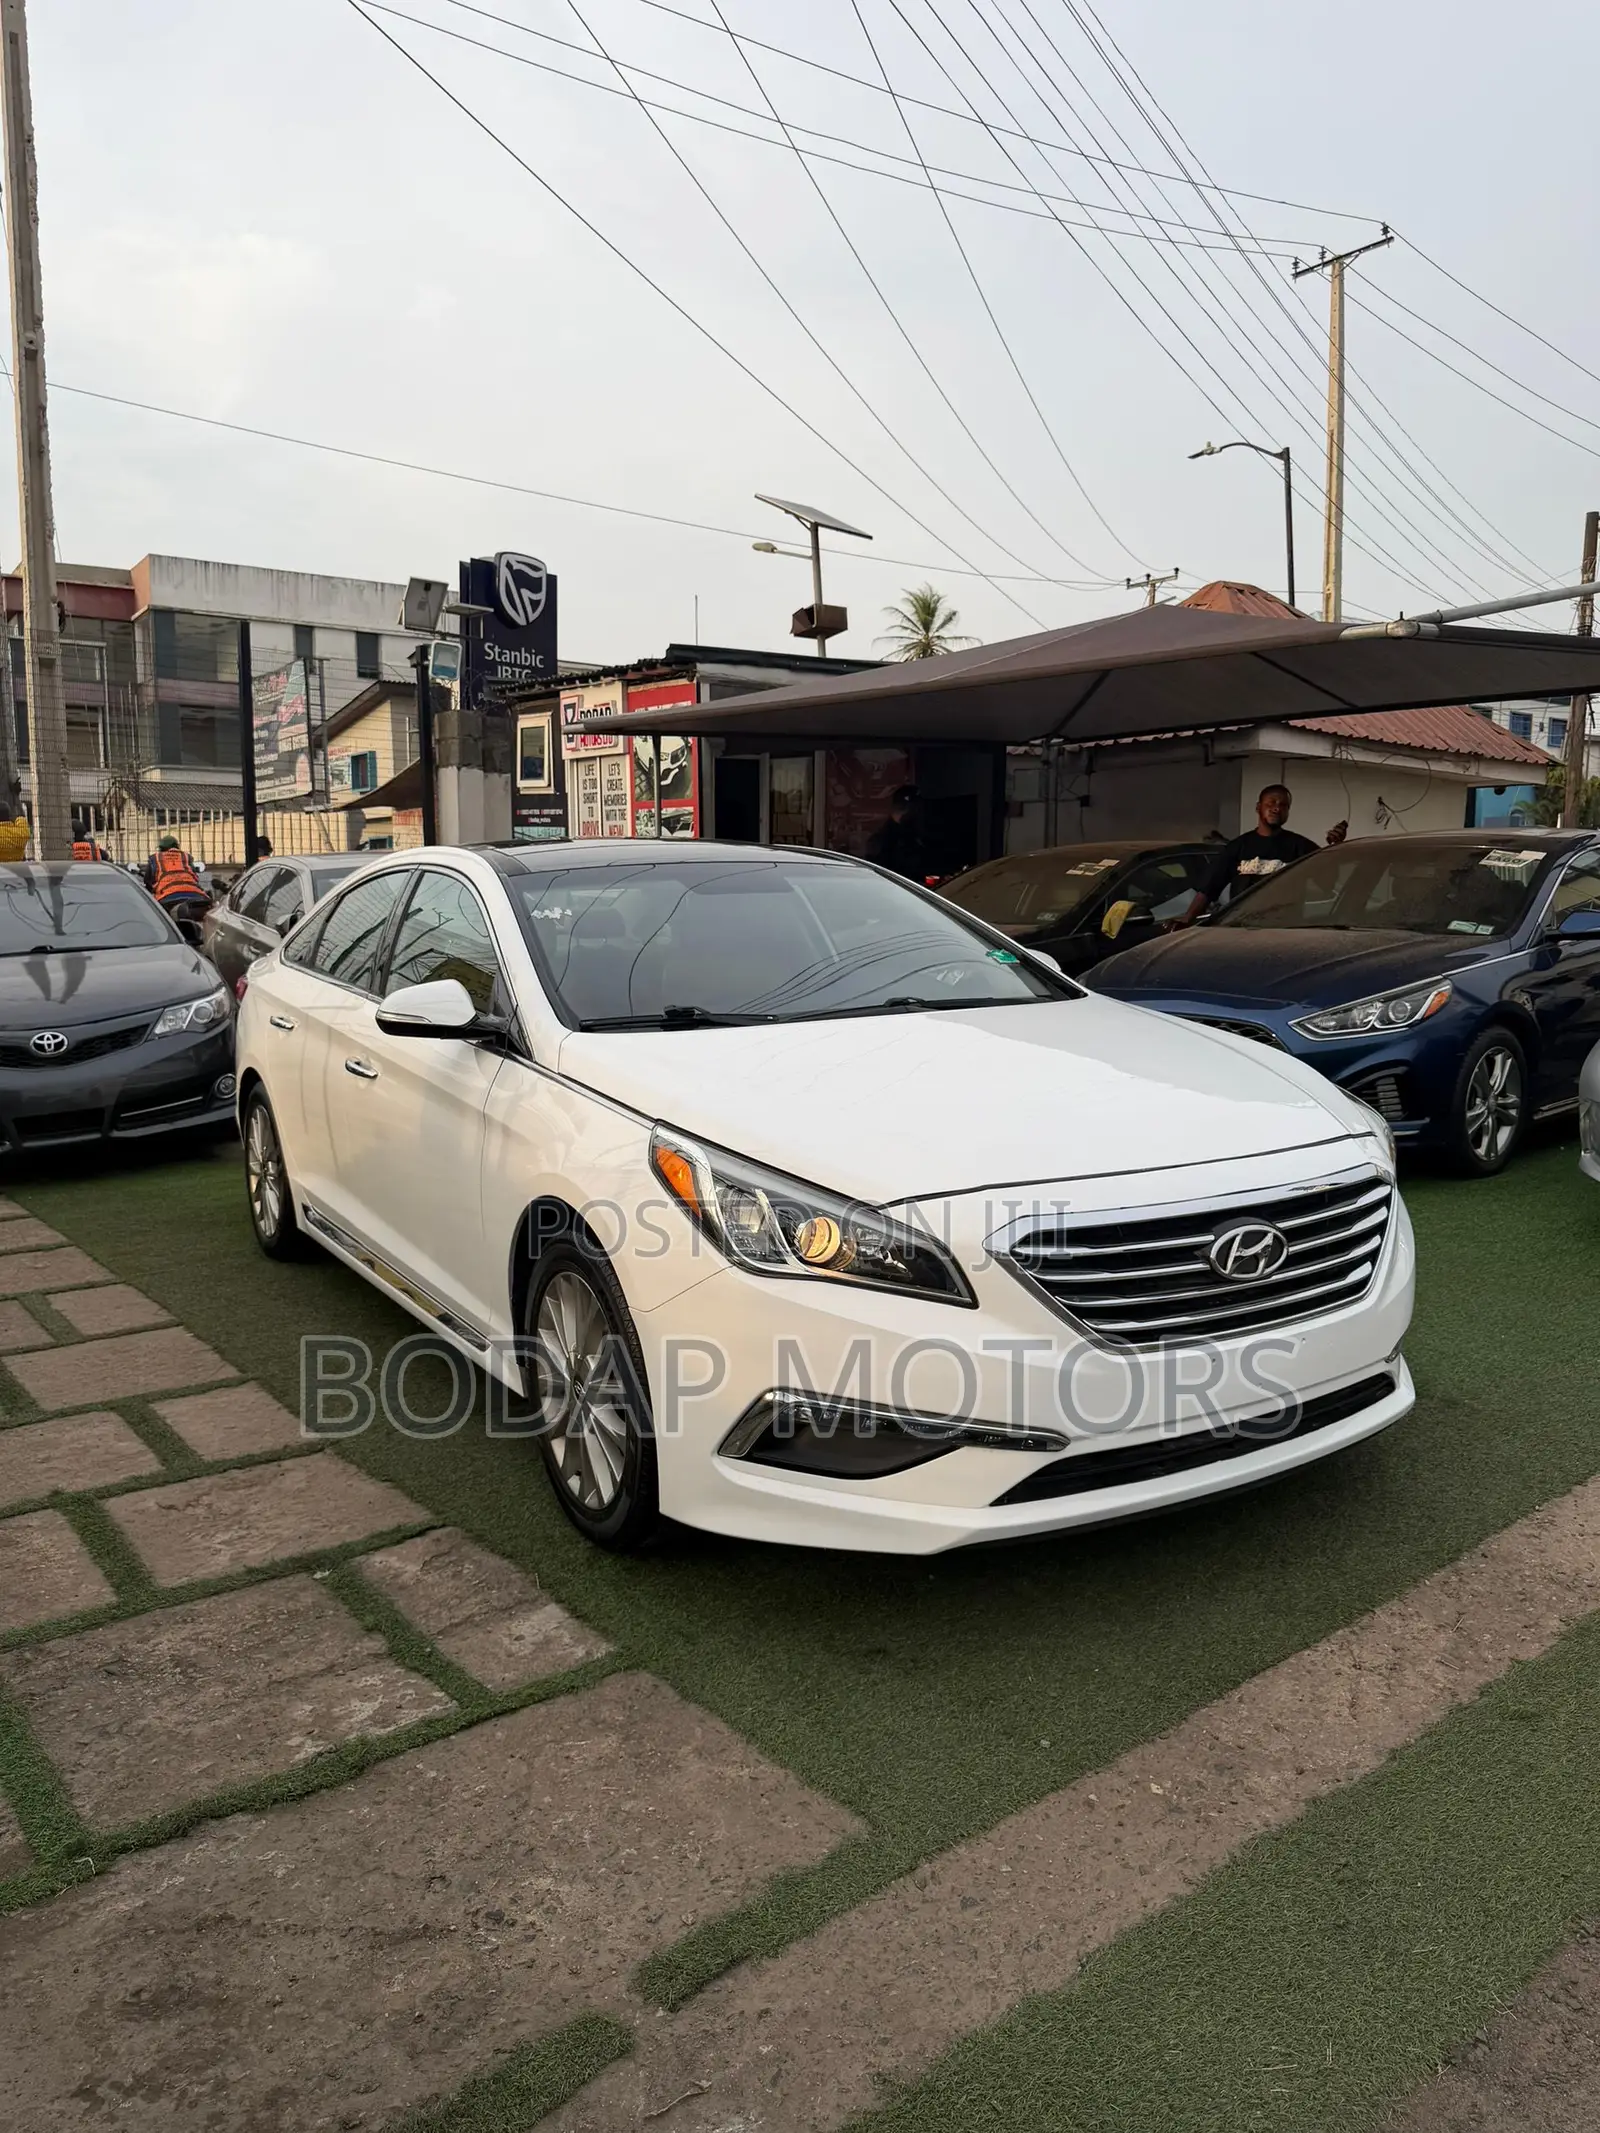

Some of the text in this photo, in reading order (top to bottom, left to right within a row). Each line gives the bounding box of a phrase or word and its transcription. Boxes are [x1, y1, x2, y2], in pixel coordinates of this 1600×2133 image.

[484, 642, 544, 668] Stanbic
[584, 764, 595, 776] LIFE
[608, 762, 621, 776] LET'S
[583, 778, 597, 790] IS TOO
[607, 778, 623, 792] CREATE
[583, 792, 597, 804] SHORT
[604, 793, 627, 806] MEMORIES
[588, 806, 594, 818] TO
[605, 808, 627, 821] WITH THE
[583, 821, 599, 836] DRIVE
